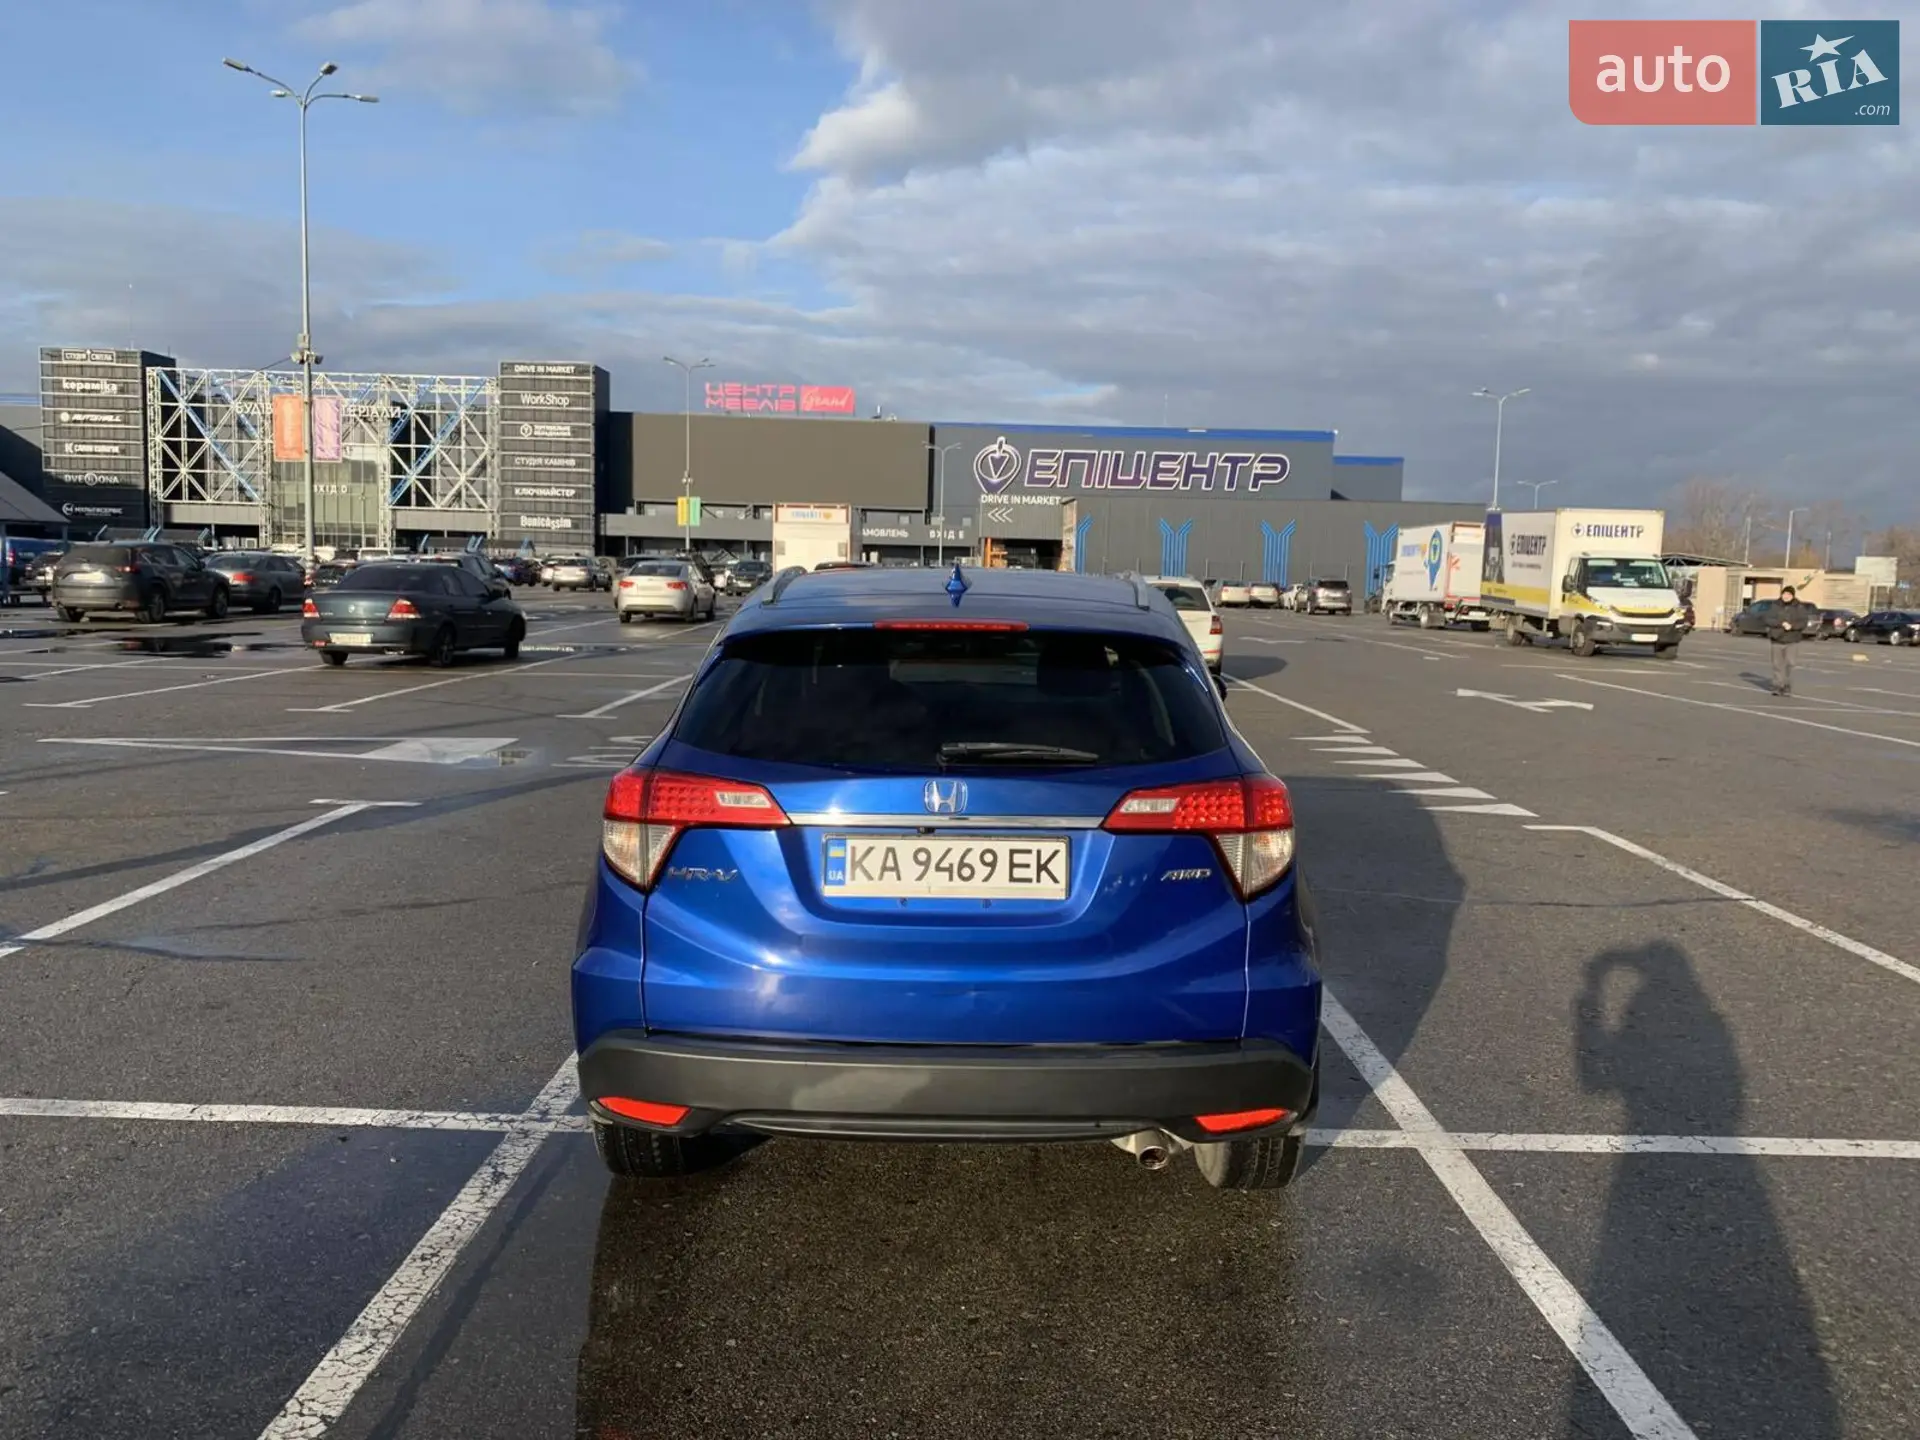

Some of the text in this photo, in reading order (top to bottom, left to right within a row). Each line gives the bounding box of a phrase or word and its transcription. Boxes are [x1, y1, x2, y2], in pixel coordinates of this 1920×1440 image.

[514, 364, 575, 374] DRIVE IN MARKET
[705, 382, 796, 397] ЦЕНТР
[520, 393, 570, 408] WorkShop
[705, 397, 796, 412] МЕБЛІВ
[341, 405, 401, 419] ТЕРІАЛИ
[1024, 449, 1290, 492] ЕПІЦЕНТР
[981, 494, 1061, 505] DRIVE IN MARKET
[862, 528, 909, 538] АМОВЛЕНЬ
[1586, 524, 1644, 538] ЕПІЦЕНТР
[1516, 534, 1547, 556] ЕПІЦЕНТР
[828, 846, 1061, 884] UA KA 9469 EK
